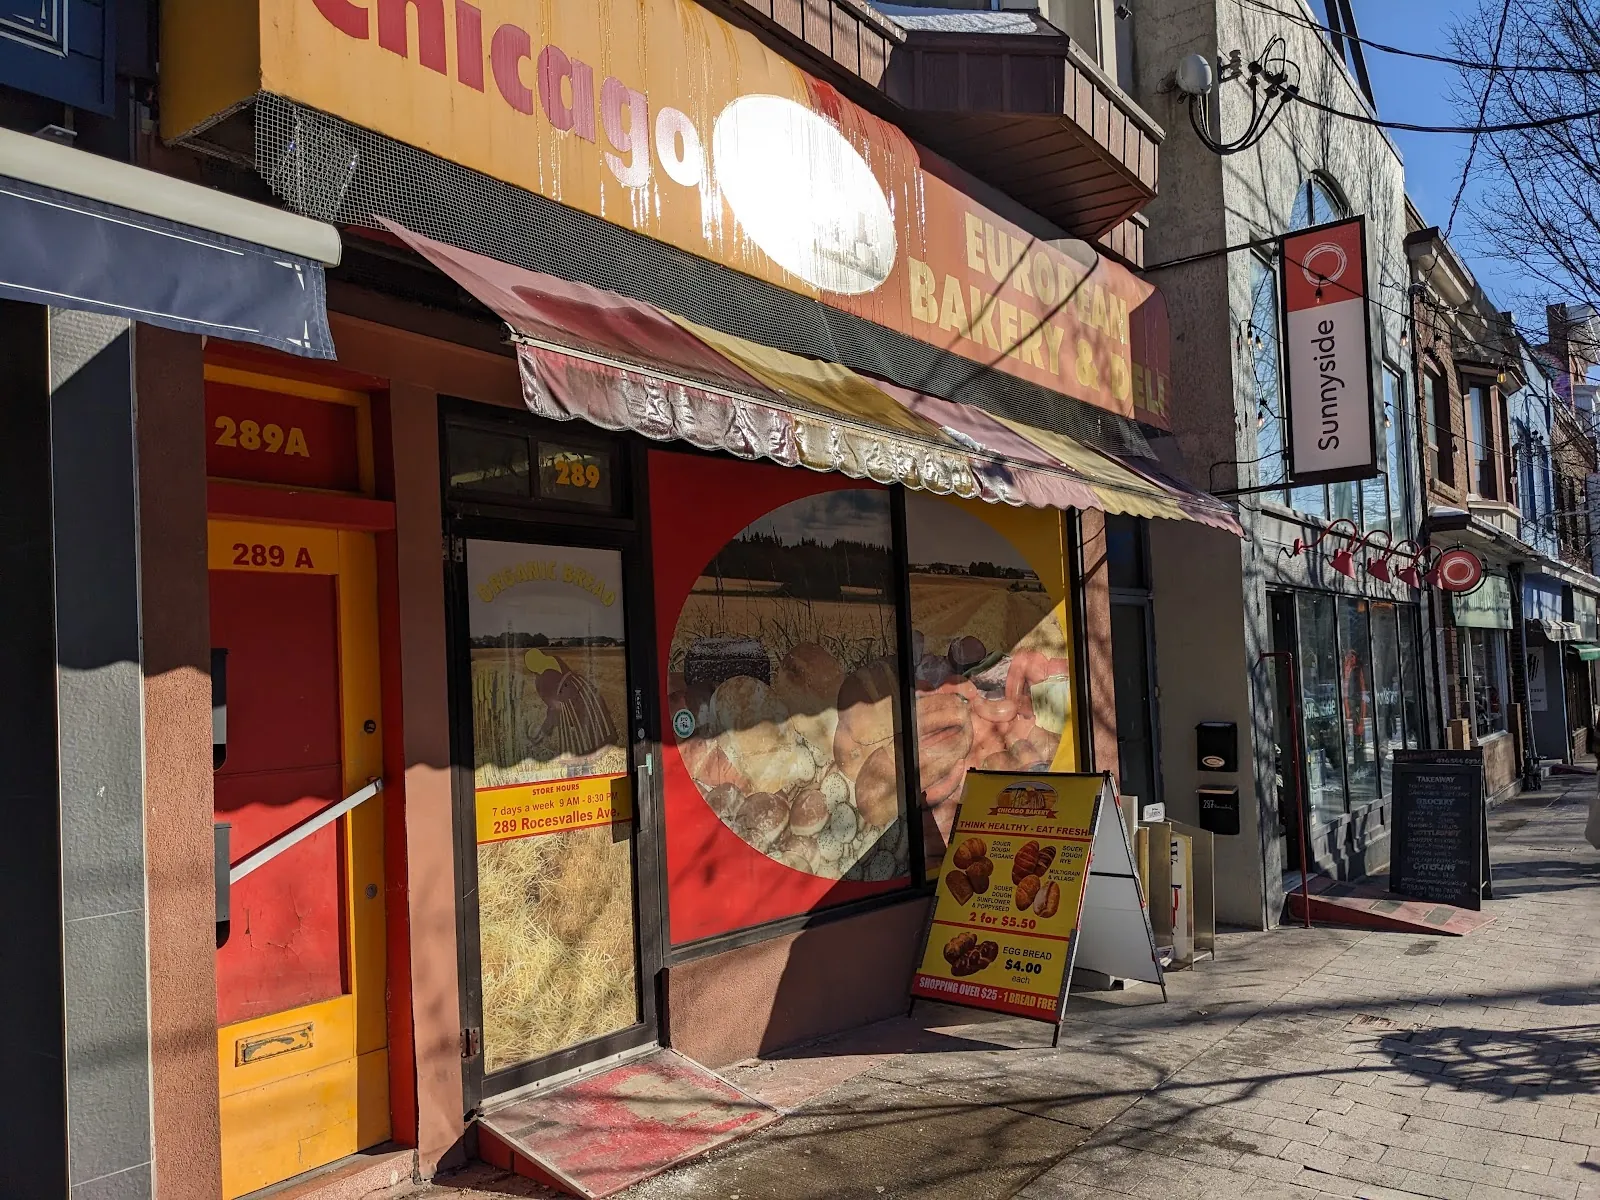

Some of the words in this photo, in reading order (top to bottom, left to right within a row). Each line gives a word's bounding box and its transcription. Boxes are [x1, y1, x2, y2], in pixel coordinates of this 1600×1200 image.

[965, 211, 1128, 345] EUROPEAN
[908, 256, 1065, 376] BAKERY
[1075, 339, 1100, 392] &
[1110, 352, 1165, 416] DELI
[1311, 319, 1345, 451] Sunnyside
[214, 415, 310, 458] 289A
[555, 460, 600, 489] 289
[232, 543, 285, 567] 289
[294, 547, 314, 568] A
[476, 560, 557, 602] ORGANIC
[562, 563, 616, 607] BREAD
[532, 786, 554, 796] STORE
[555, 783, 580, 792] HOURS
[492, 807, 498, 816] 7
[500, 804, 522, 817] days
[524, 804, 530, 812] a
[532, 799, 555, 811] week
[559, 798, 565, 808] 9
[566, 796, 580, 806] AM
[587, 793, 604, 804] 8:30
[606, 791, 618, 801] PM
[997, 807, 1025, 815] CHICAGO
[1025, 808, 1050, 816] BAKERY
[493, 819, 517, 835] 289
[521, 811, 593, 831] Rocesvalles
[596, 806, 620, 820] Ave.
[960, 820, 986, 830] THINK
[988, 822, 1029, 832] HEALTHY
[1036, 825, 1054, 834] EAT
[1049, 869, 1081, 877] MULTIGRAIN
[1413, 862, 1456, 872] CATERING
[993, 884, 1013, 892] SOUER
[976, 896, 1011, 905] SUNFLOWER
[977, 903, 1010, 912] POPPYSEED
[968, 911, 977, 921] 2
[980, 912, 996, 924] for
[1001, 915, 1037, 929] $5.50
[1002, 946, 1021, 956] EGG
[1022, 949, 1052, 960] BREAD
[1004, 958, 1042, 975] $4.00
[1011, 976, 1030, 984] each
[919, 976, 958, 994] SHOPPING
[959, 984, 980, 997] OVER
[980, 987, 998, 1001] $25
[1003, 992, 1008, 1003] 1
[1009, 992, 1036, 1007] BREAD
[1037, 997, 1057, 1011] FREE
